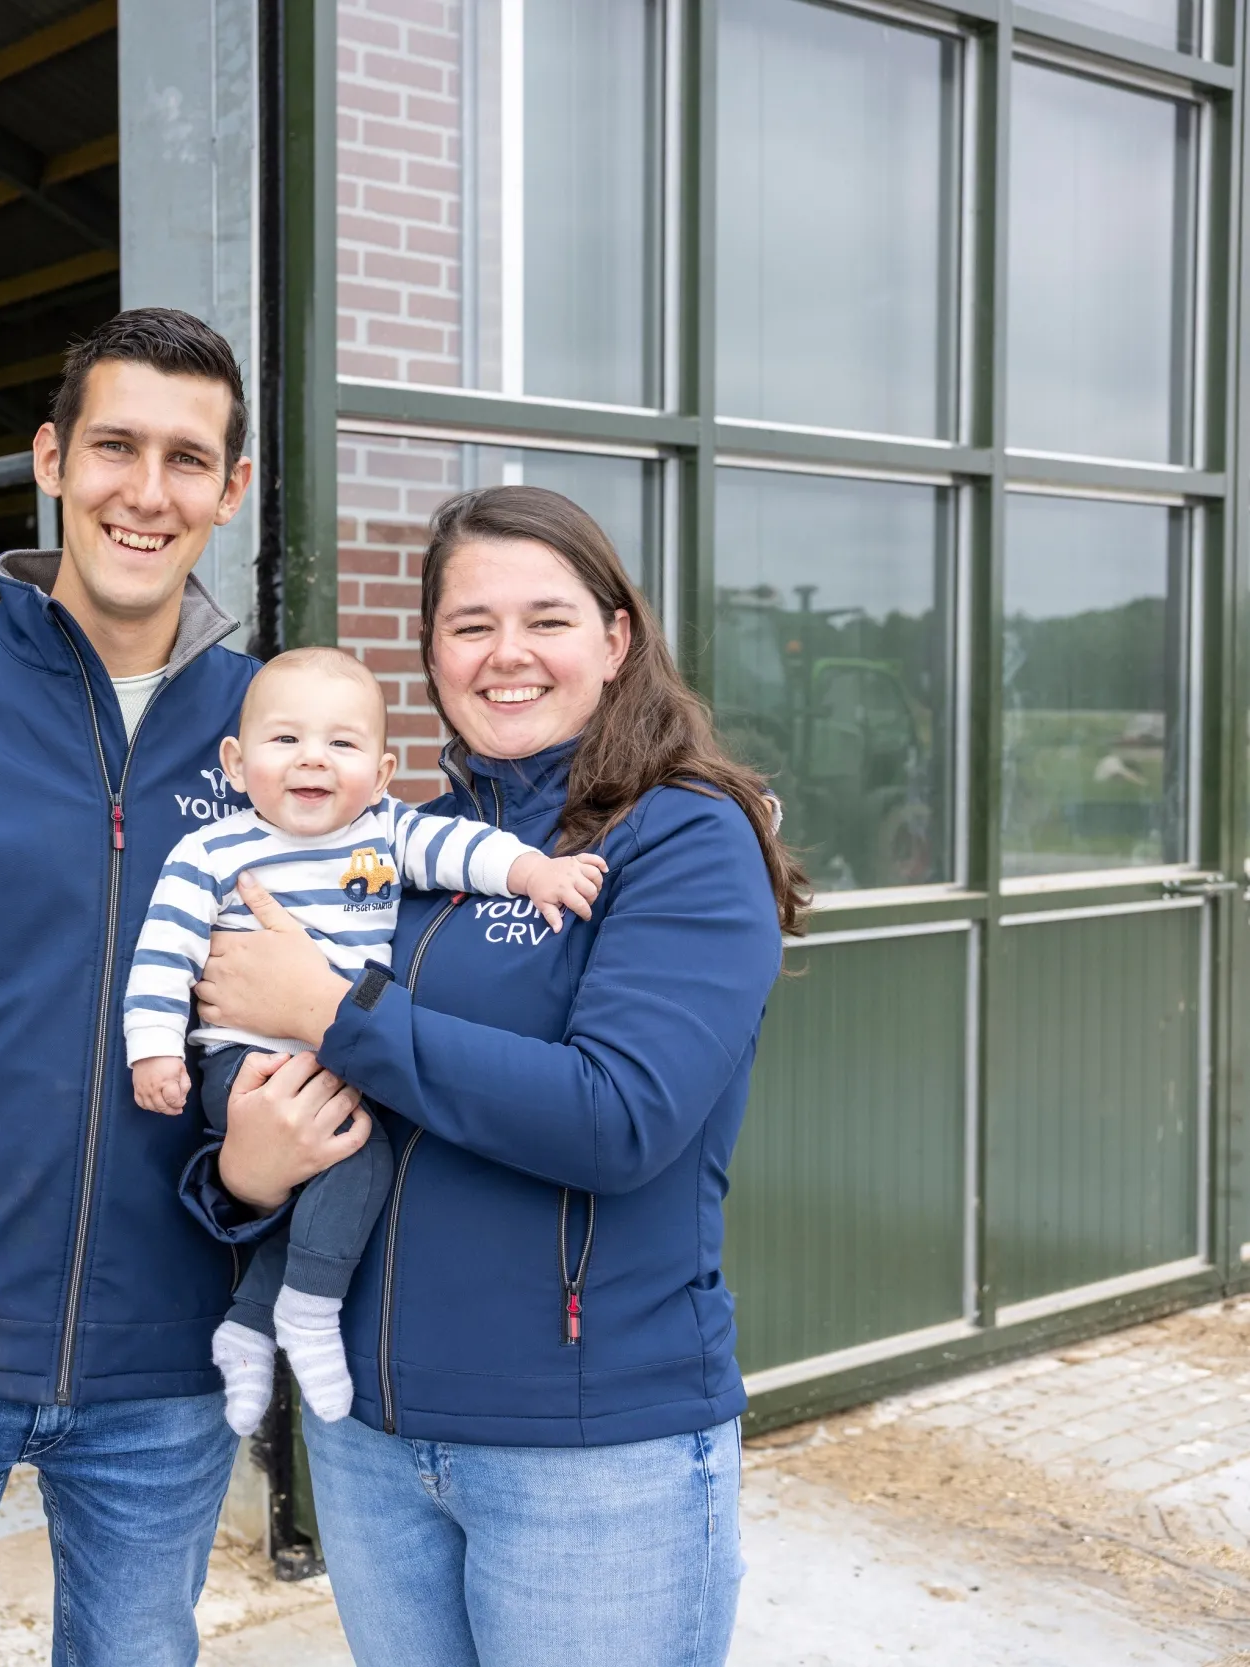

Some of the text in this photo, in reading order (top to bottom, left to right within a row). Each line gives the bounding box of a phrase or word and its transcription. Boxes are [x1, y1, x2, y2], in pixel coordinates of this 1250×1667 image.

[343, 901, 393, 912] LET'S GET STARTED
[474, 899, 566, 919] YOU
[485, 922, 550, 946] CRV
